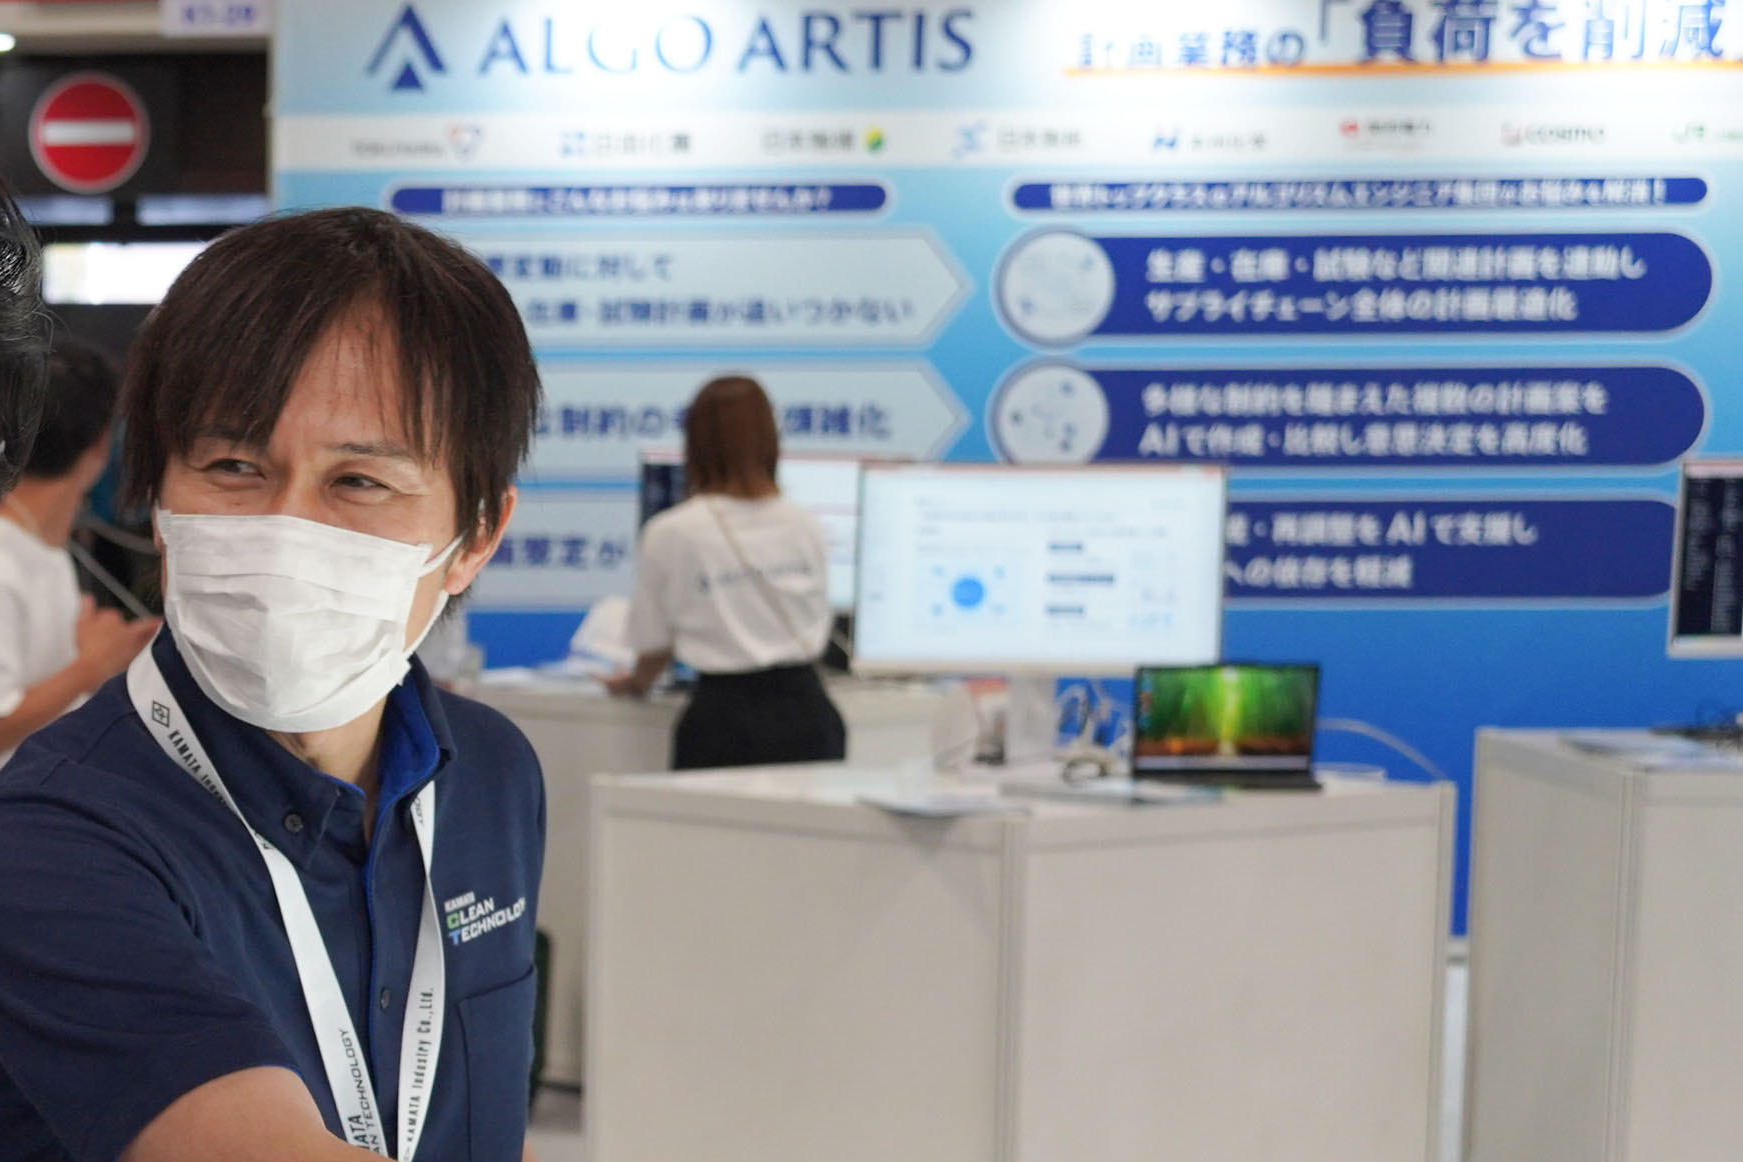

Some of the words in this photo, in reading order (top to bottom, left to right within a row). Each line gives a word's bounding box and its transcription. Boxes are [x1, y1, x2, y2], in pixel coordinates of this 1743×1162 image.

[737, 8, 976, 71] ARTIS
[166, 729, 203, 777] KAMATA
[446, 897, 495, 929] CLEAN
[339, 1028, 378, 1132] TECHNOLOGY
[411, 1029, 434, 1081] Industry
[348, 1112, 368, 1155] ATA
[405, 1084, 423, 1142] KAMATA
